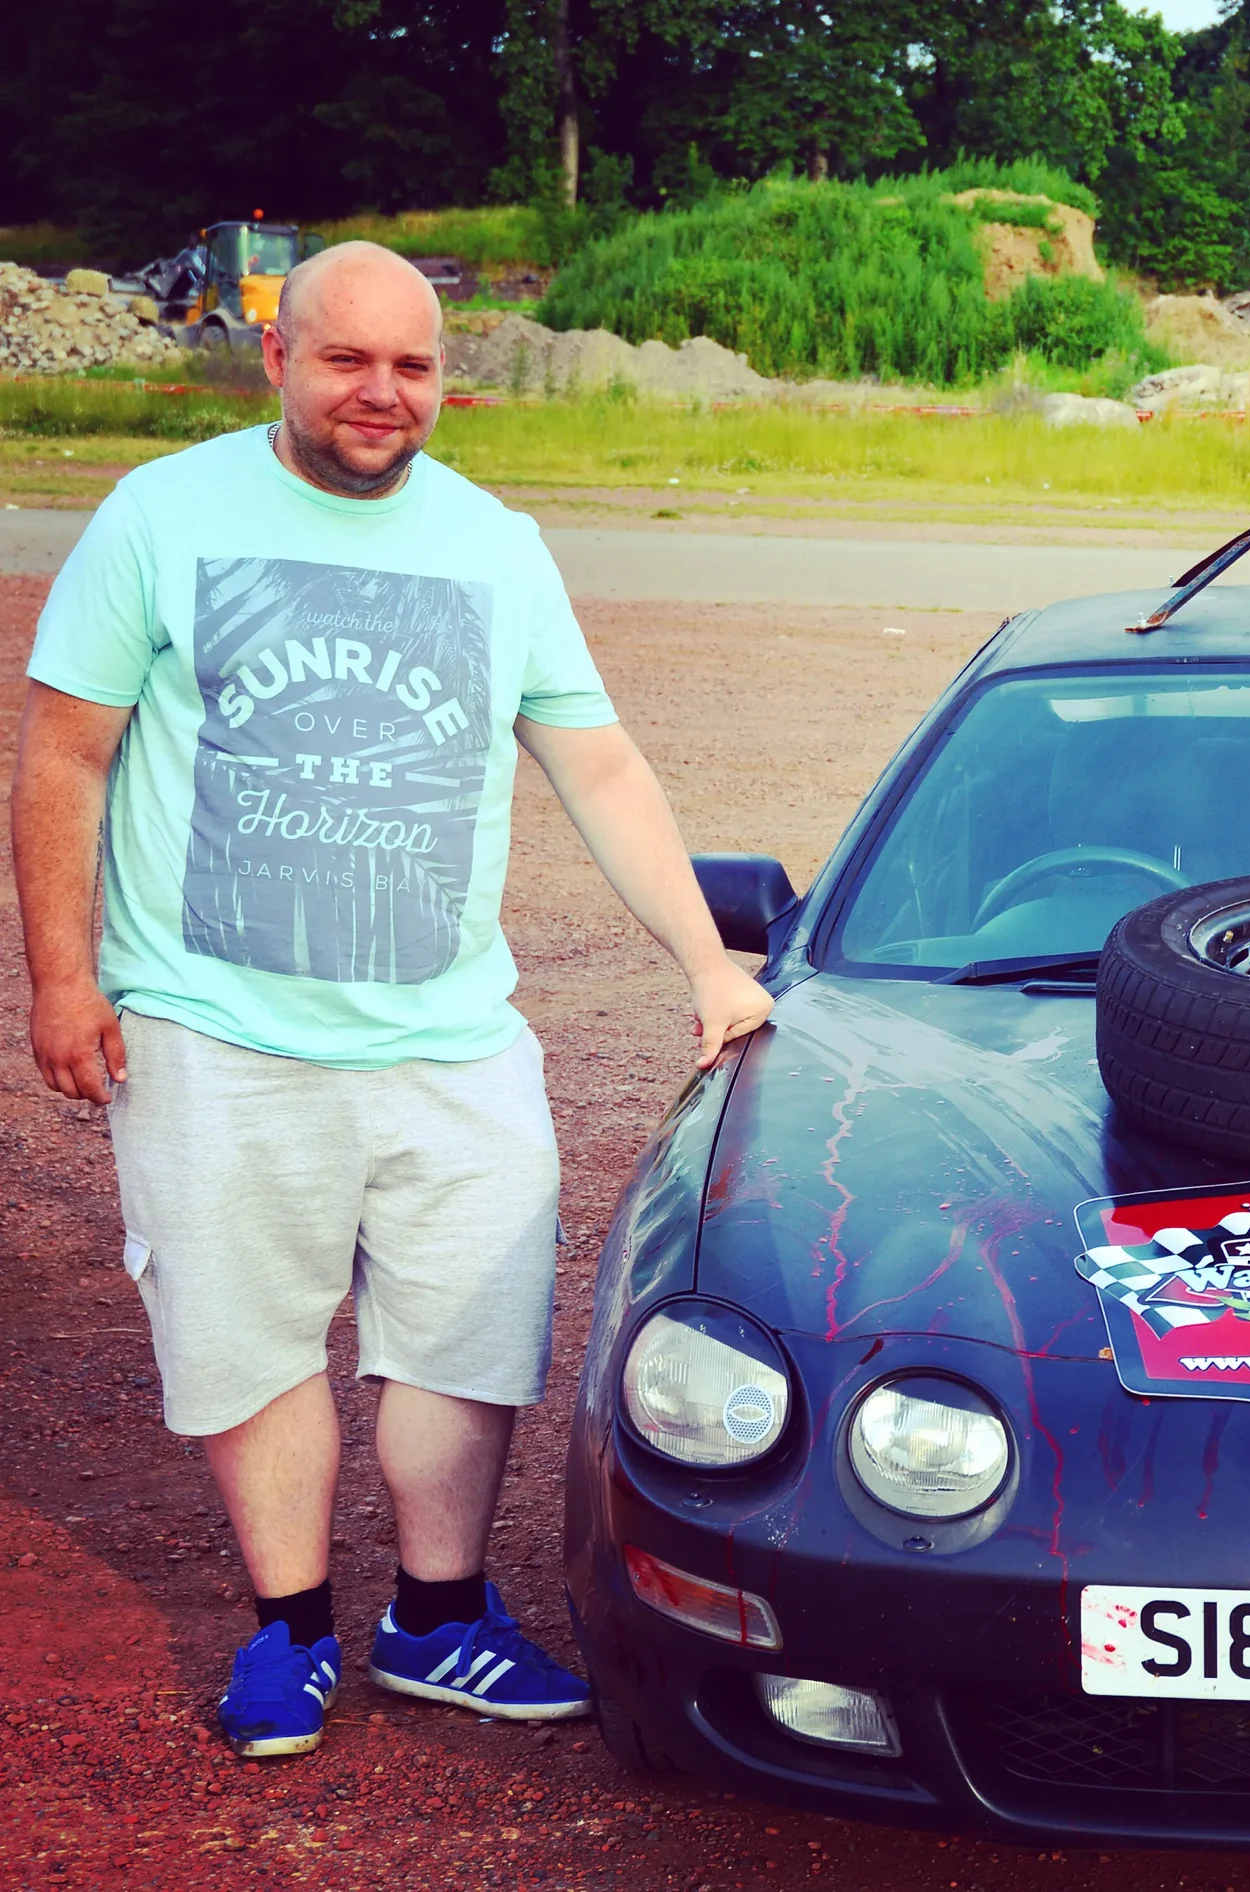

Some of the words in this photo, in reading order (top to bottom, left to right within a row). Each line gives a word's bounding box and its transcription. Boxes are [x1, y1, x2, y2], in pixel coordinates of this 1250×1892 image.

[306, 609, 362, 631] watch
[365, 612, 394, 633] the
[218, 637, 469, 746] SUNRISE
[294, 711, 396, 742] OVER
[295, 753, 394, 789] THE
[236, 788, 439, 854] Horizon
[238, 860, 355, 889] JARVIS
